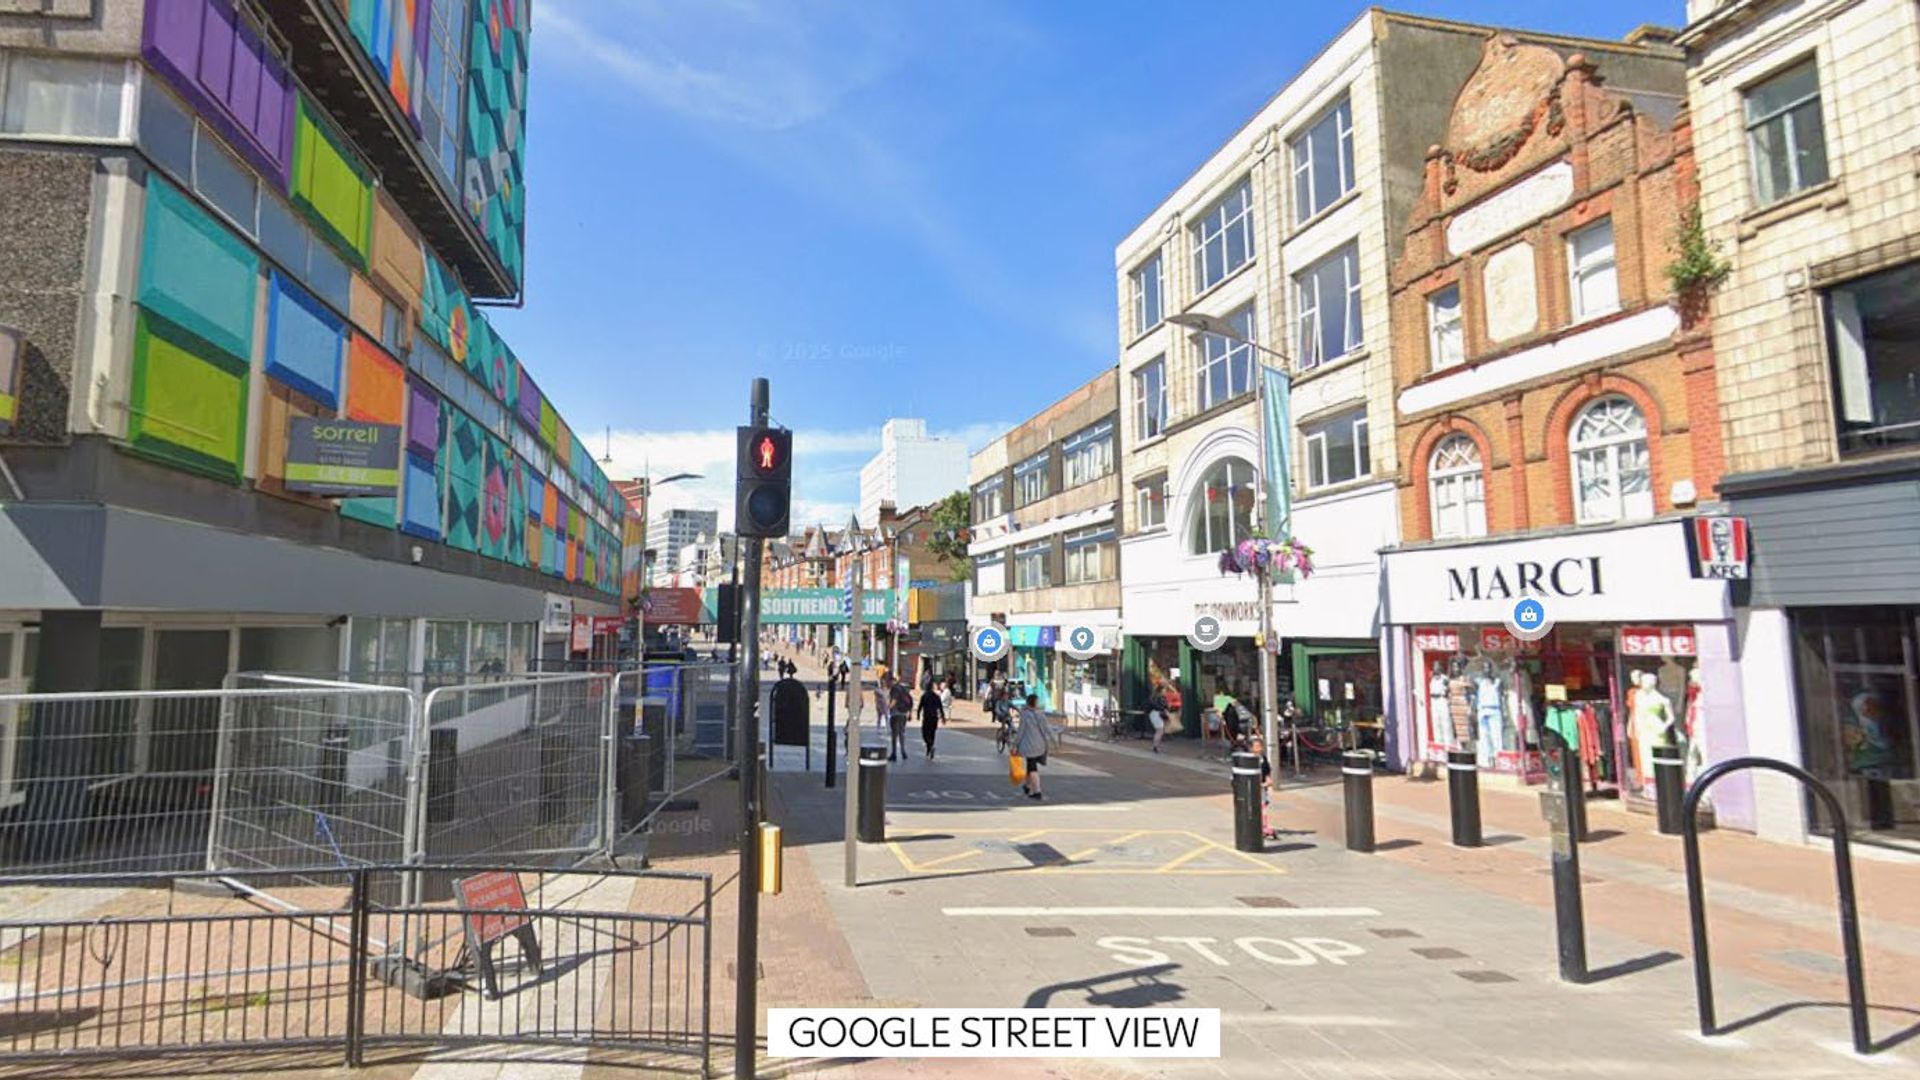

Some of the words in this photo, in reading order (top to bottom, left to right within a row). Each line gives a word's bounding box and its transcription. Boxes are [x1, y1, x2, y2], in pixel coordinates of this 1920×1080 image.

[312, 426, 378, 443] sorrell
[1448, 556, 1605, 600] MARCI
[1709, 564, 1742, 579] KFC
[1416, 629, 1458, 651] sale
[1625, 627, 1692, 654] sale
[1096, 936, 1367, 966] STOP
